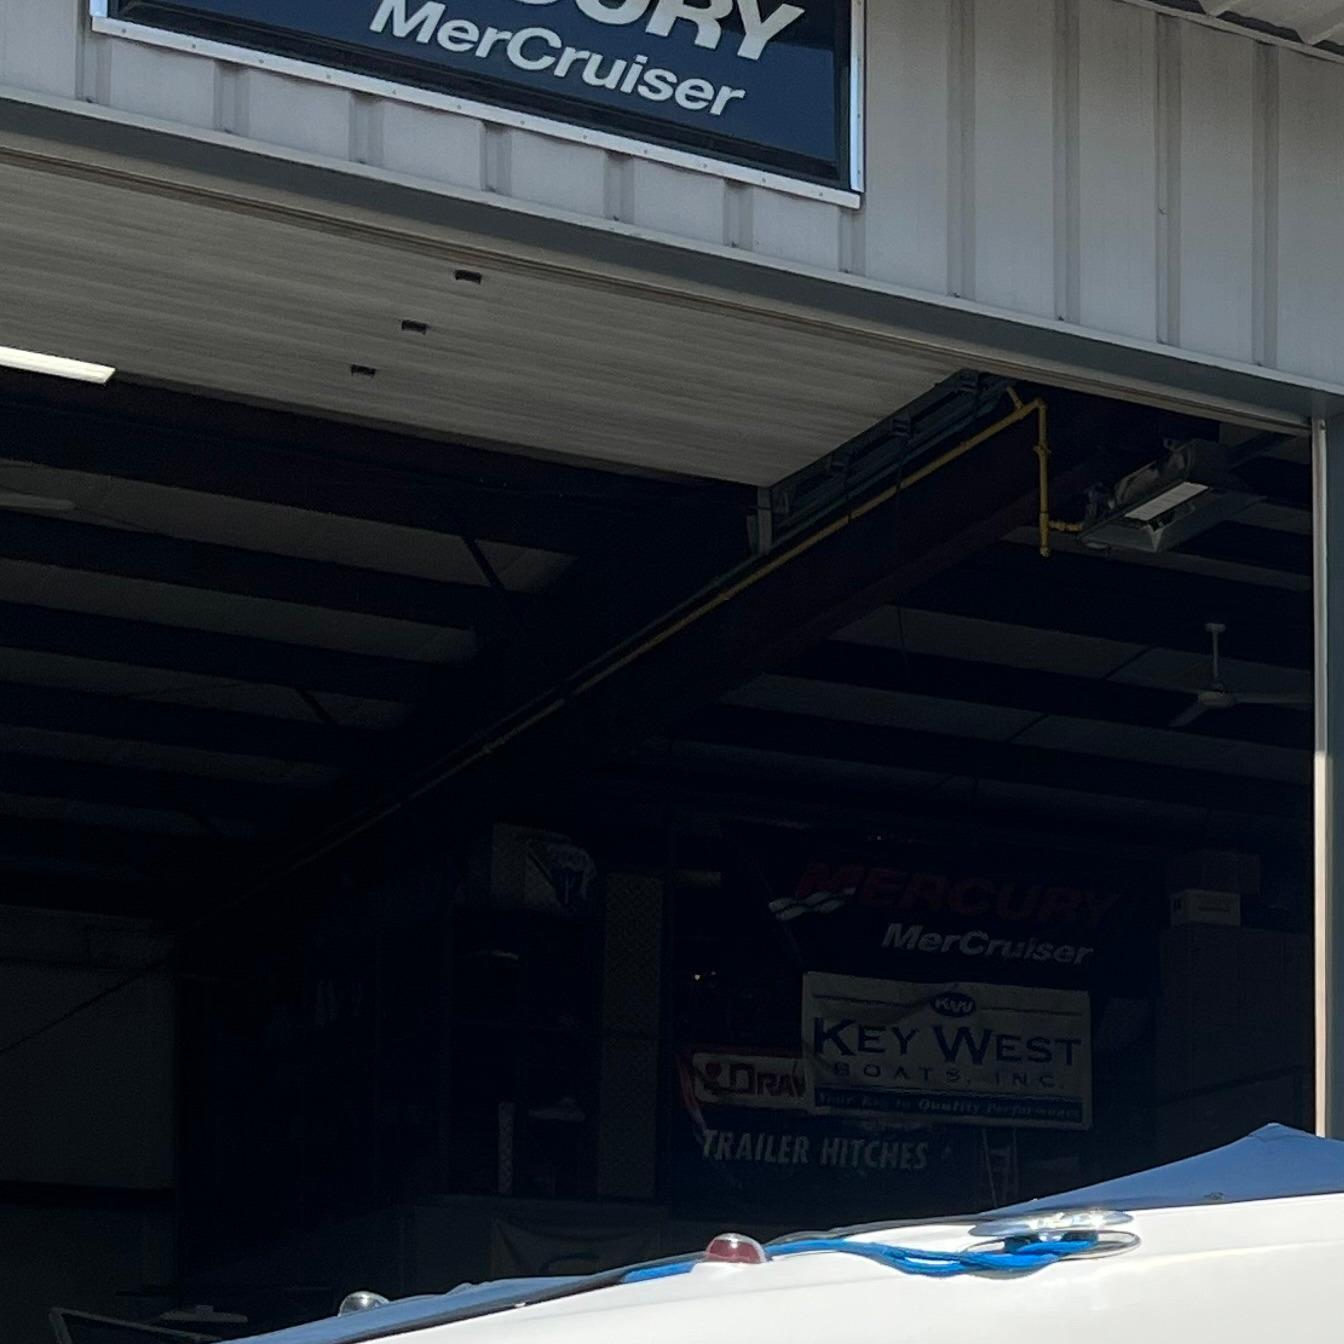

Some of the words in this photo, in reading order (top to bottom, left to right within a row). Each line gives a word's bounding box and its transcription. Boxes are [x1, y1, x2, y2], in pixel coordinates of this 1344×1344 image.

[369, 0, 746, 116] MerCruiser
[794, 862, 1121, 927] MERCURY
[880, 922, 1095, 966] MerCruiser
[813, 1016, 920, 1057] KEY
[931, 1022, 1082, 1066] WEST
[701, 1128, 809, 1165] TRAILER
[819, 1135, 929, 1169] HITCHES
